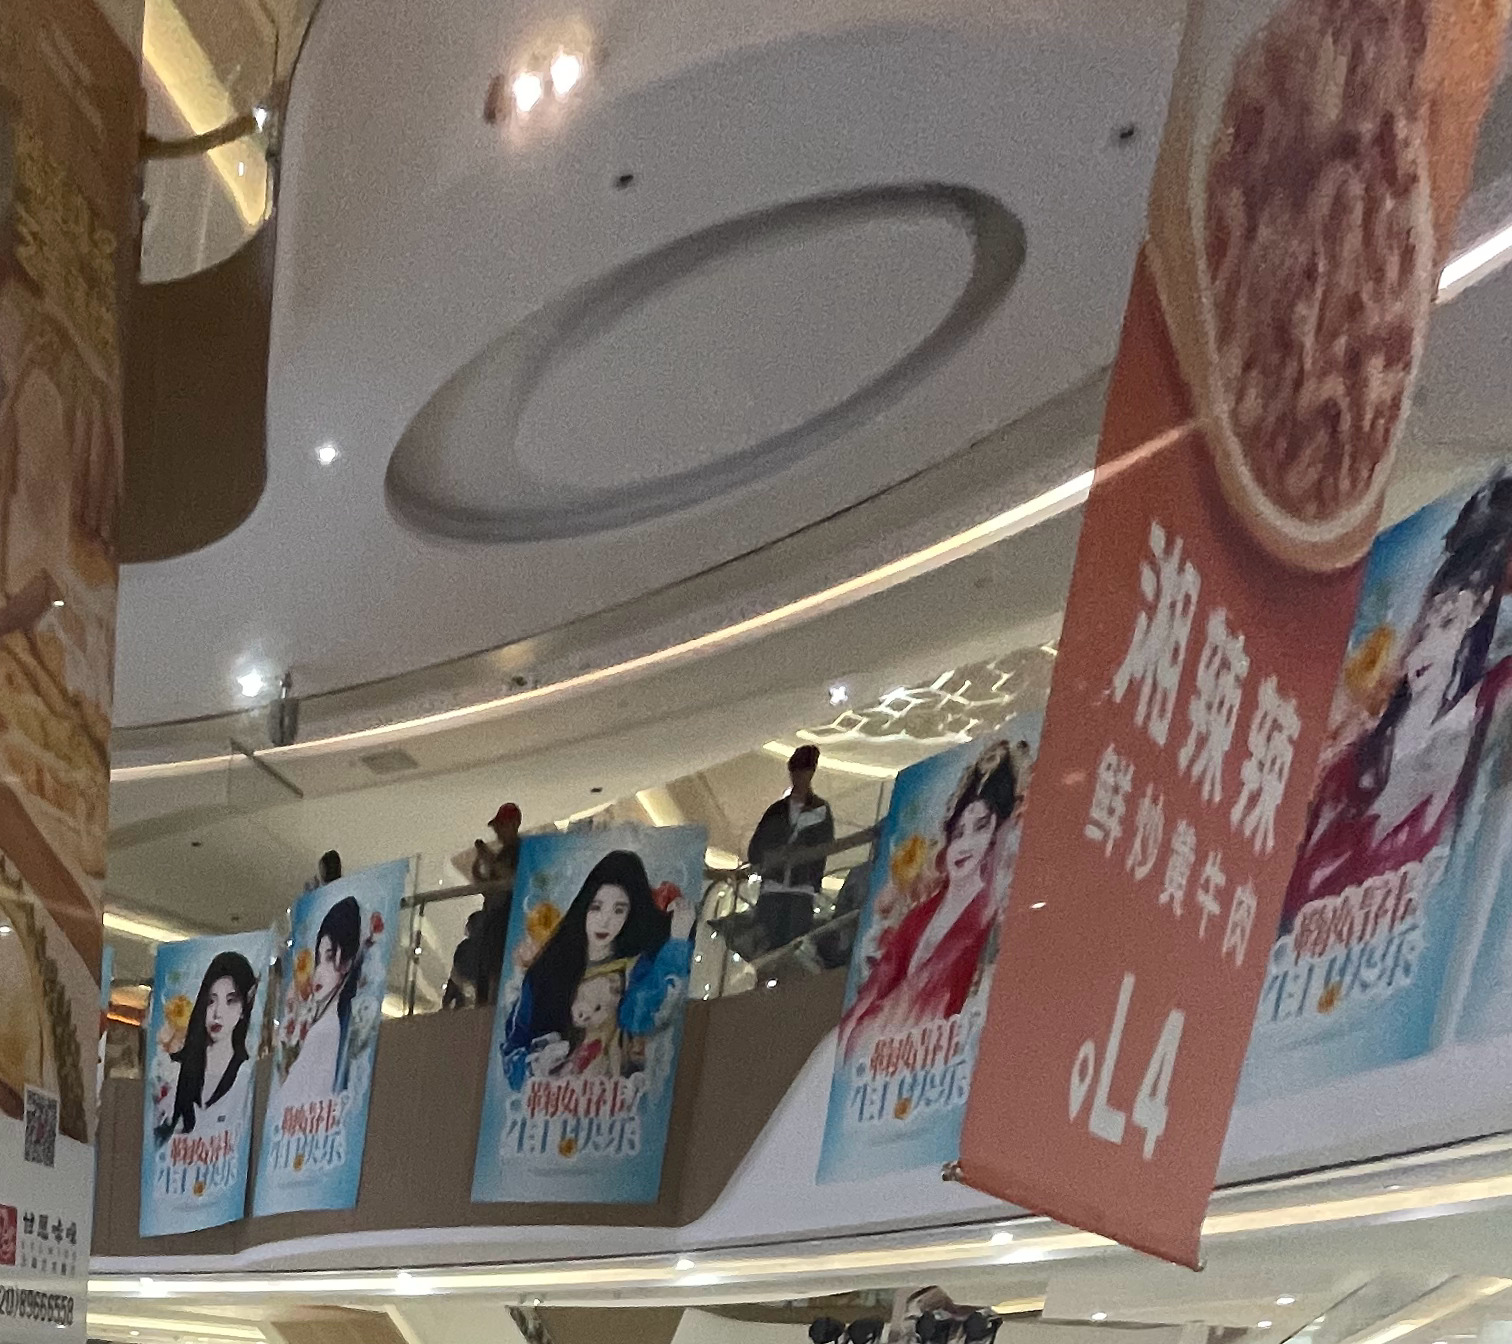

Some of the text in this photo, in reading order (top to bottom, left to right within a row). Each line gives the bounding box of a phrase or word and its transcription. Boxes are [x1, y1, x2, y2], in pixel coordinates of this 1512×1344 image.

[1085, 744, 1258, 967] 鲜炒黄牛肉
[1089, 971, 1185, 1161] L4
